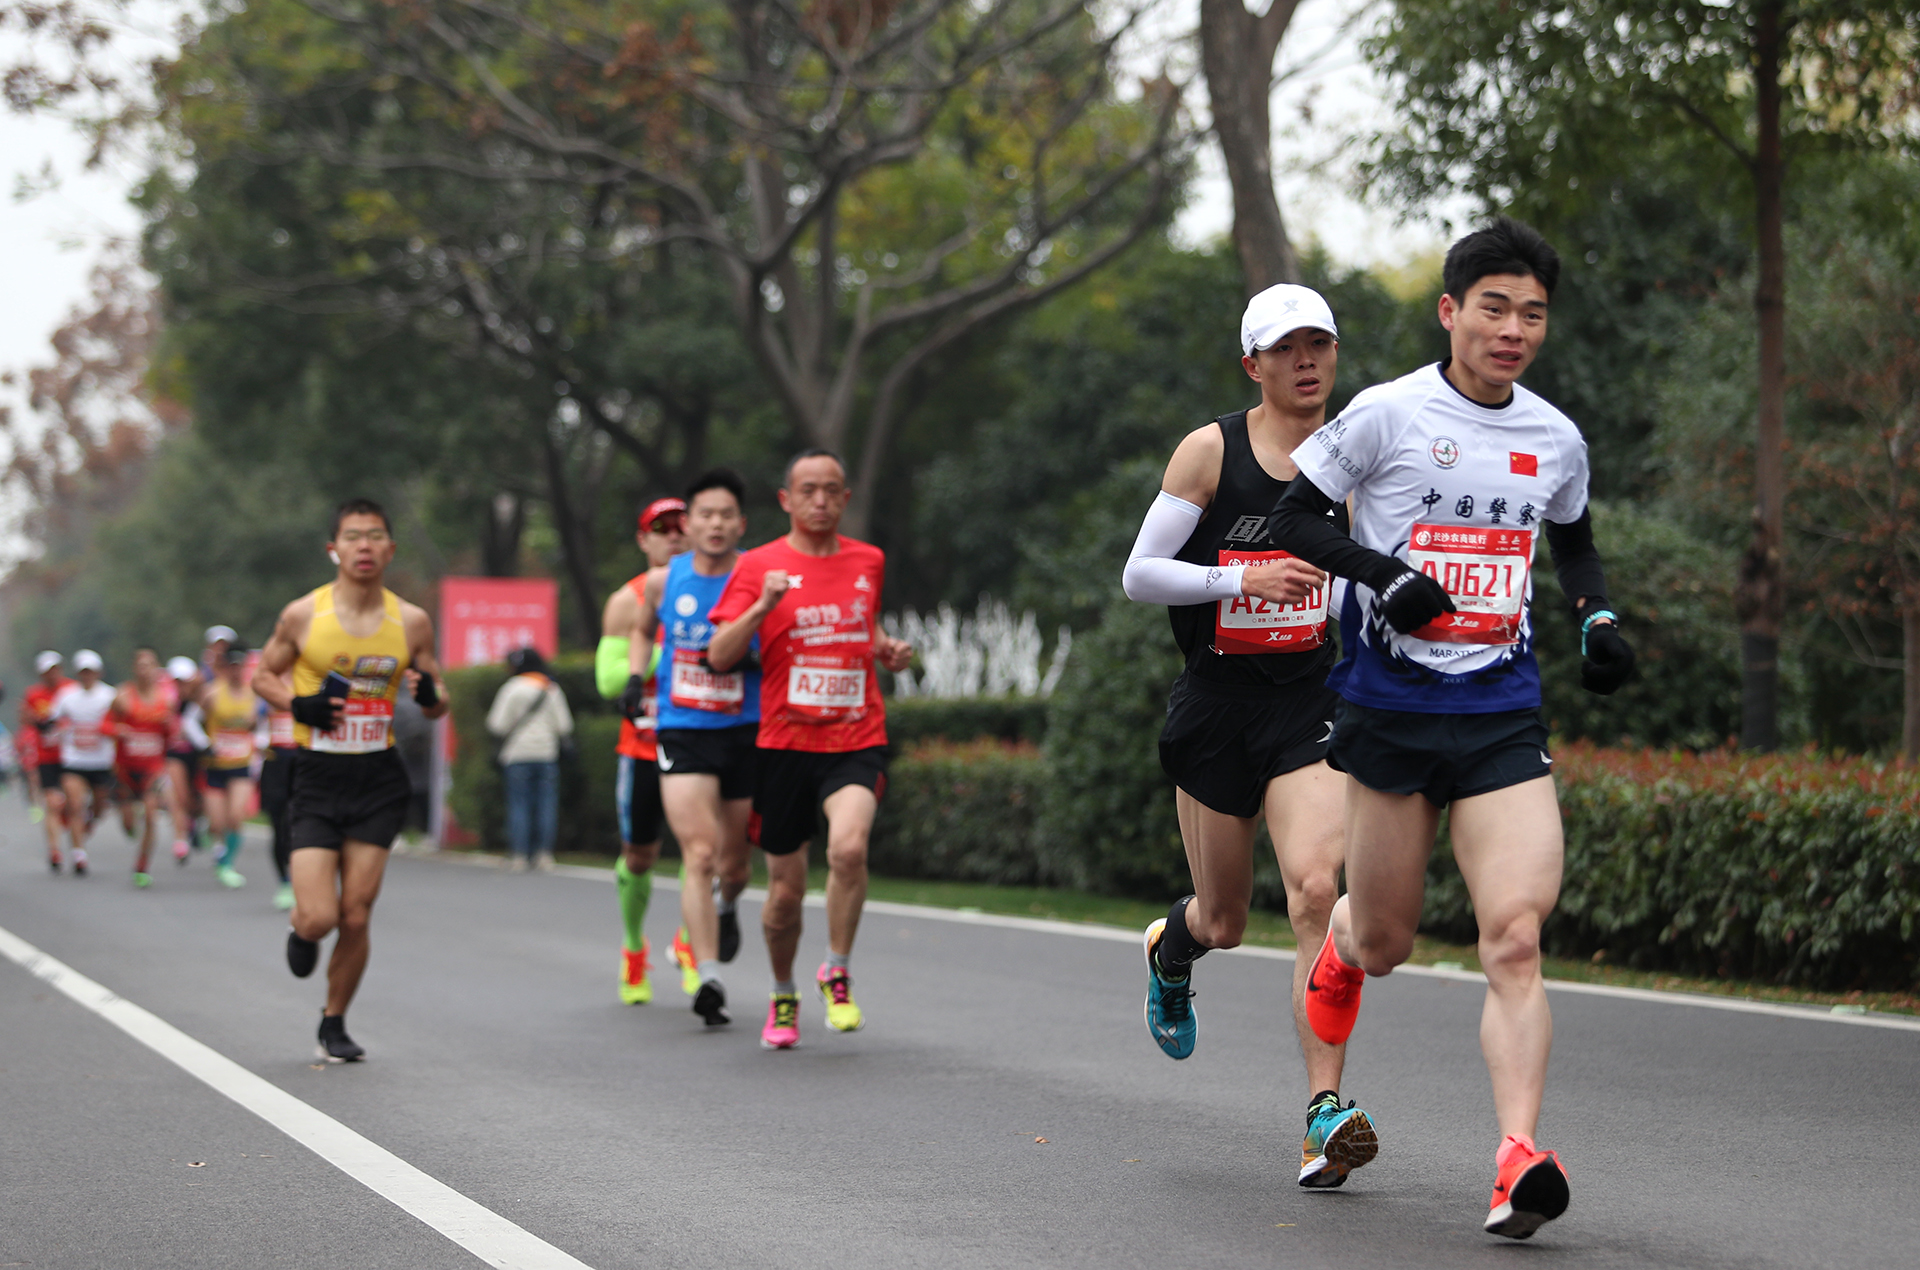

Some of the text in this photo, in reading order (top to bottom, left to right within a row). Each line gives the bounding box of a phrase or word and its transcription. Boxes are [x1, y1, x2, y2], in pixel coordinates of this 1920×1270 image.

[1326, 418, 1348, 440] NA
[1312, 430, 1343, 460] ATHON
[1421, 487, 1536, 526] 中国警察
[1386, 575, 1409, 596] POLICE
[1420, 560, 1512, 598] A0621
[795, 603, 842, 627] 2019
